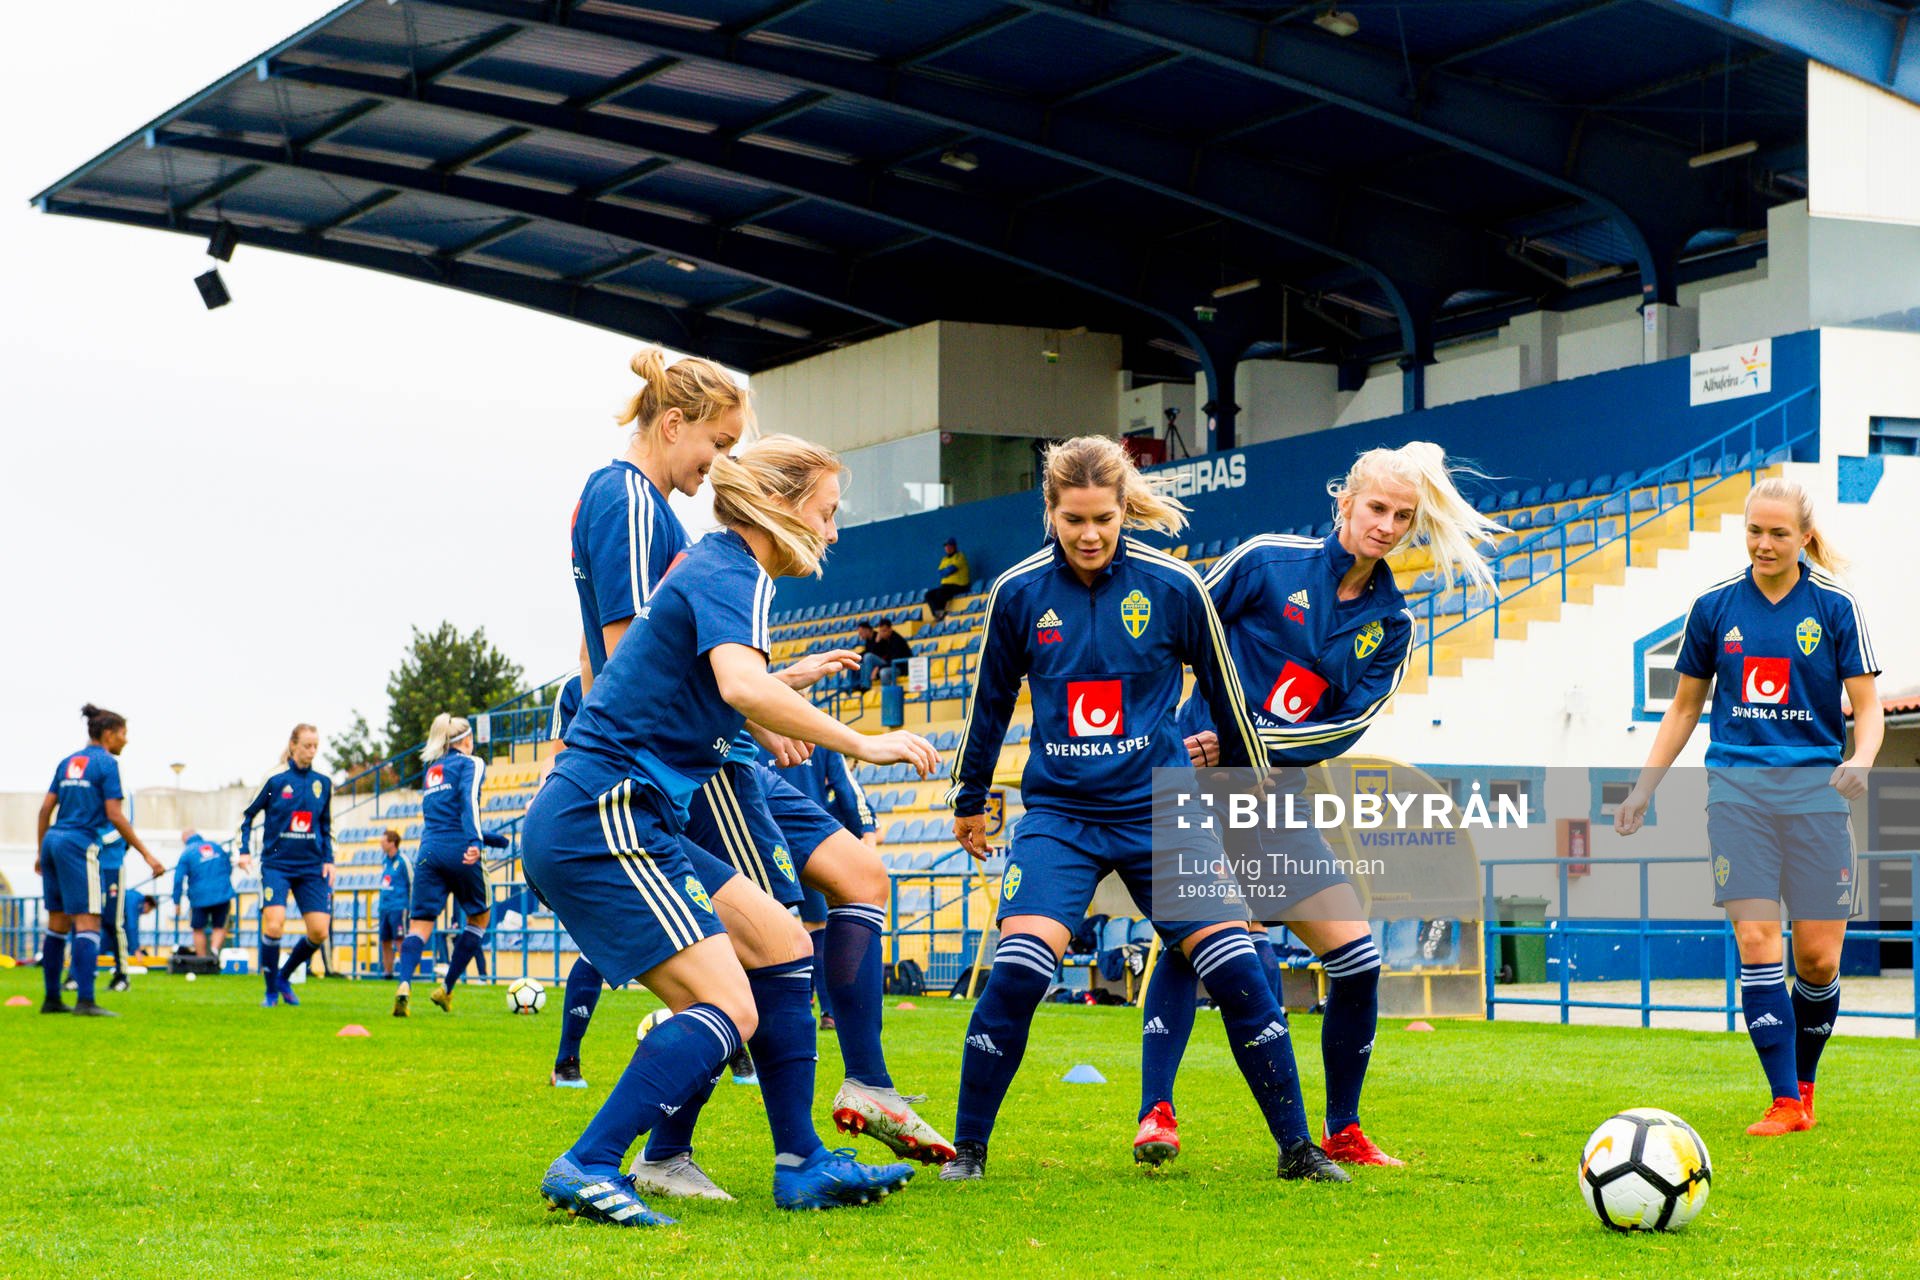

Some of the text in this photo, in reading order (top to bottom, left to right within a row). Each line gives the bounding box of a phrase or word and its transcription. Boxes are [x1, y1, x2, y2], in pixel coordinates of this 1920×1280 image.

[1283, 603, 1305, 625] ICA
[1036, 619, 1063, 628] adidas
[1037, 629, 1063, 645] ICA
[1724, 642, 1743, 654] ICA
[1731, 705, 1813, 721] SVNSKA SPEL
[1045, 735, 1150, 757] SVENSKA SPEL
[1359, 831, 1457, 847] VISITANTE
